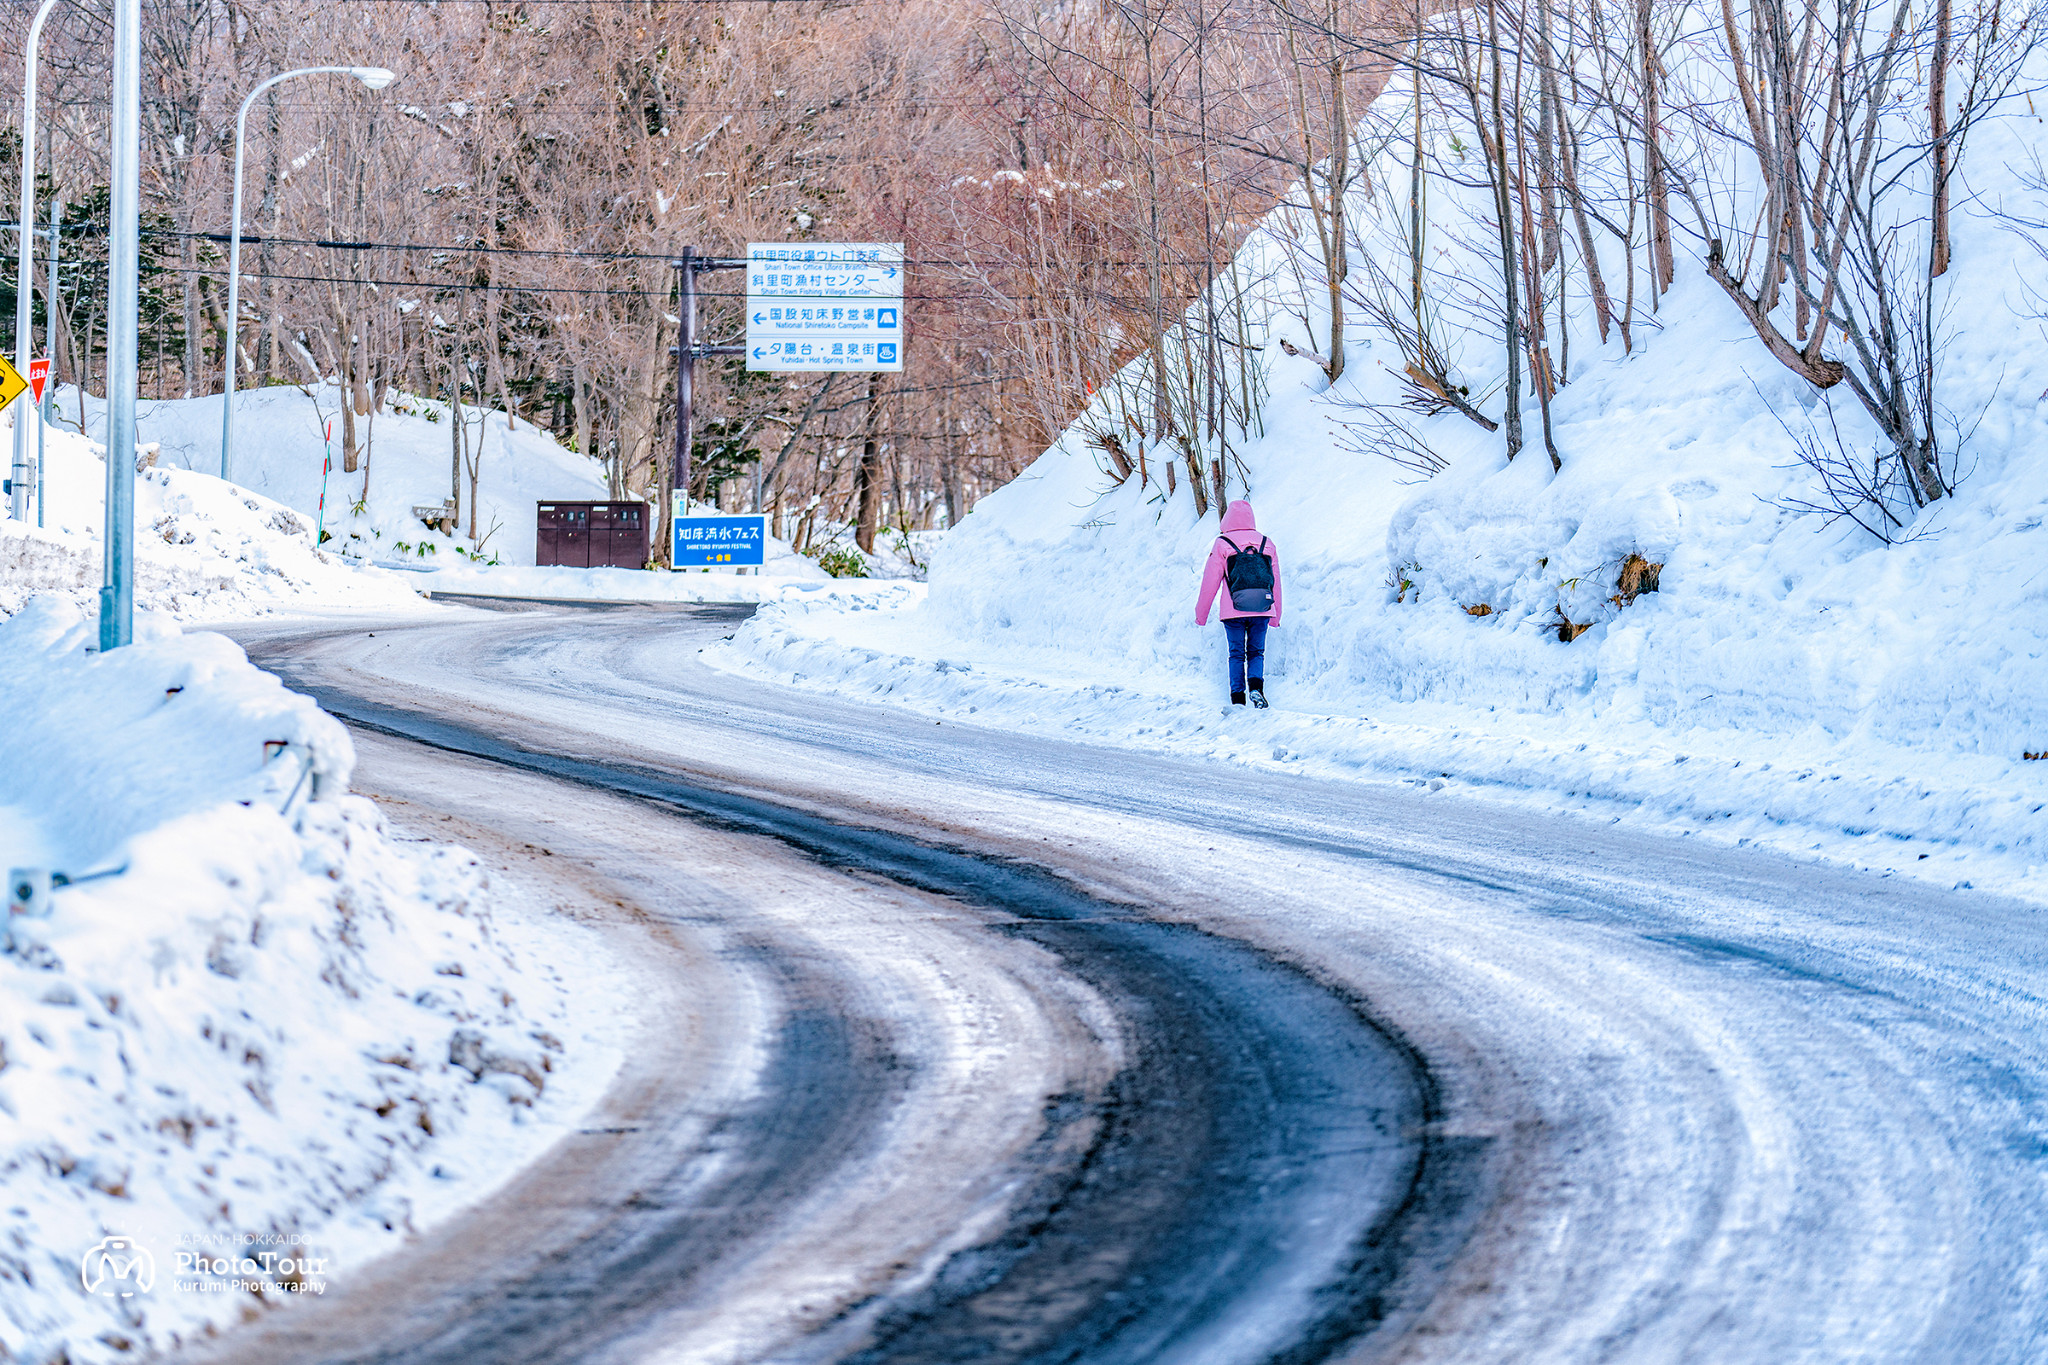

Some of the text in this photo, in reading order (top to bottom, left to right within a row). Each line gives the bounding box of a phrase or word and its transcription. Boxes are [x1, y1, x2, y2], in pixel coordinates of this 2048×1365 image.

[752, 250, 880, 262] 斜里町役場ウトロ支所
[764, 263, 781, 271] Shari
[784, 263, 801, 271] Town
[803, 263, 823, 271] Office
[752, 274, 879, 286] 斜里町漁村センター
[761, 287, 778, 295] Shari
[780, 287, 797, 295] Town
[800, 287, 823, 297] Fishing
[849, 287, 871, 295] Center
[770, 308, 875, 321] 国設知床野営場
[776, 321, 868, 330] National Shiretoko Campsite
[769, 342, 875, 355] 夕陽台・温泉街
[822, 356, 844, 365] Spring
[846, 356, 864, 364] Town
[31, 368, 46, 379] 止まれ
[678, 526, 760, 541] 知床流氷フェス
